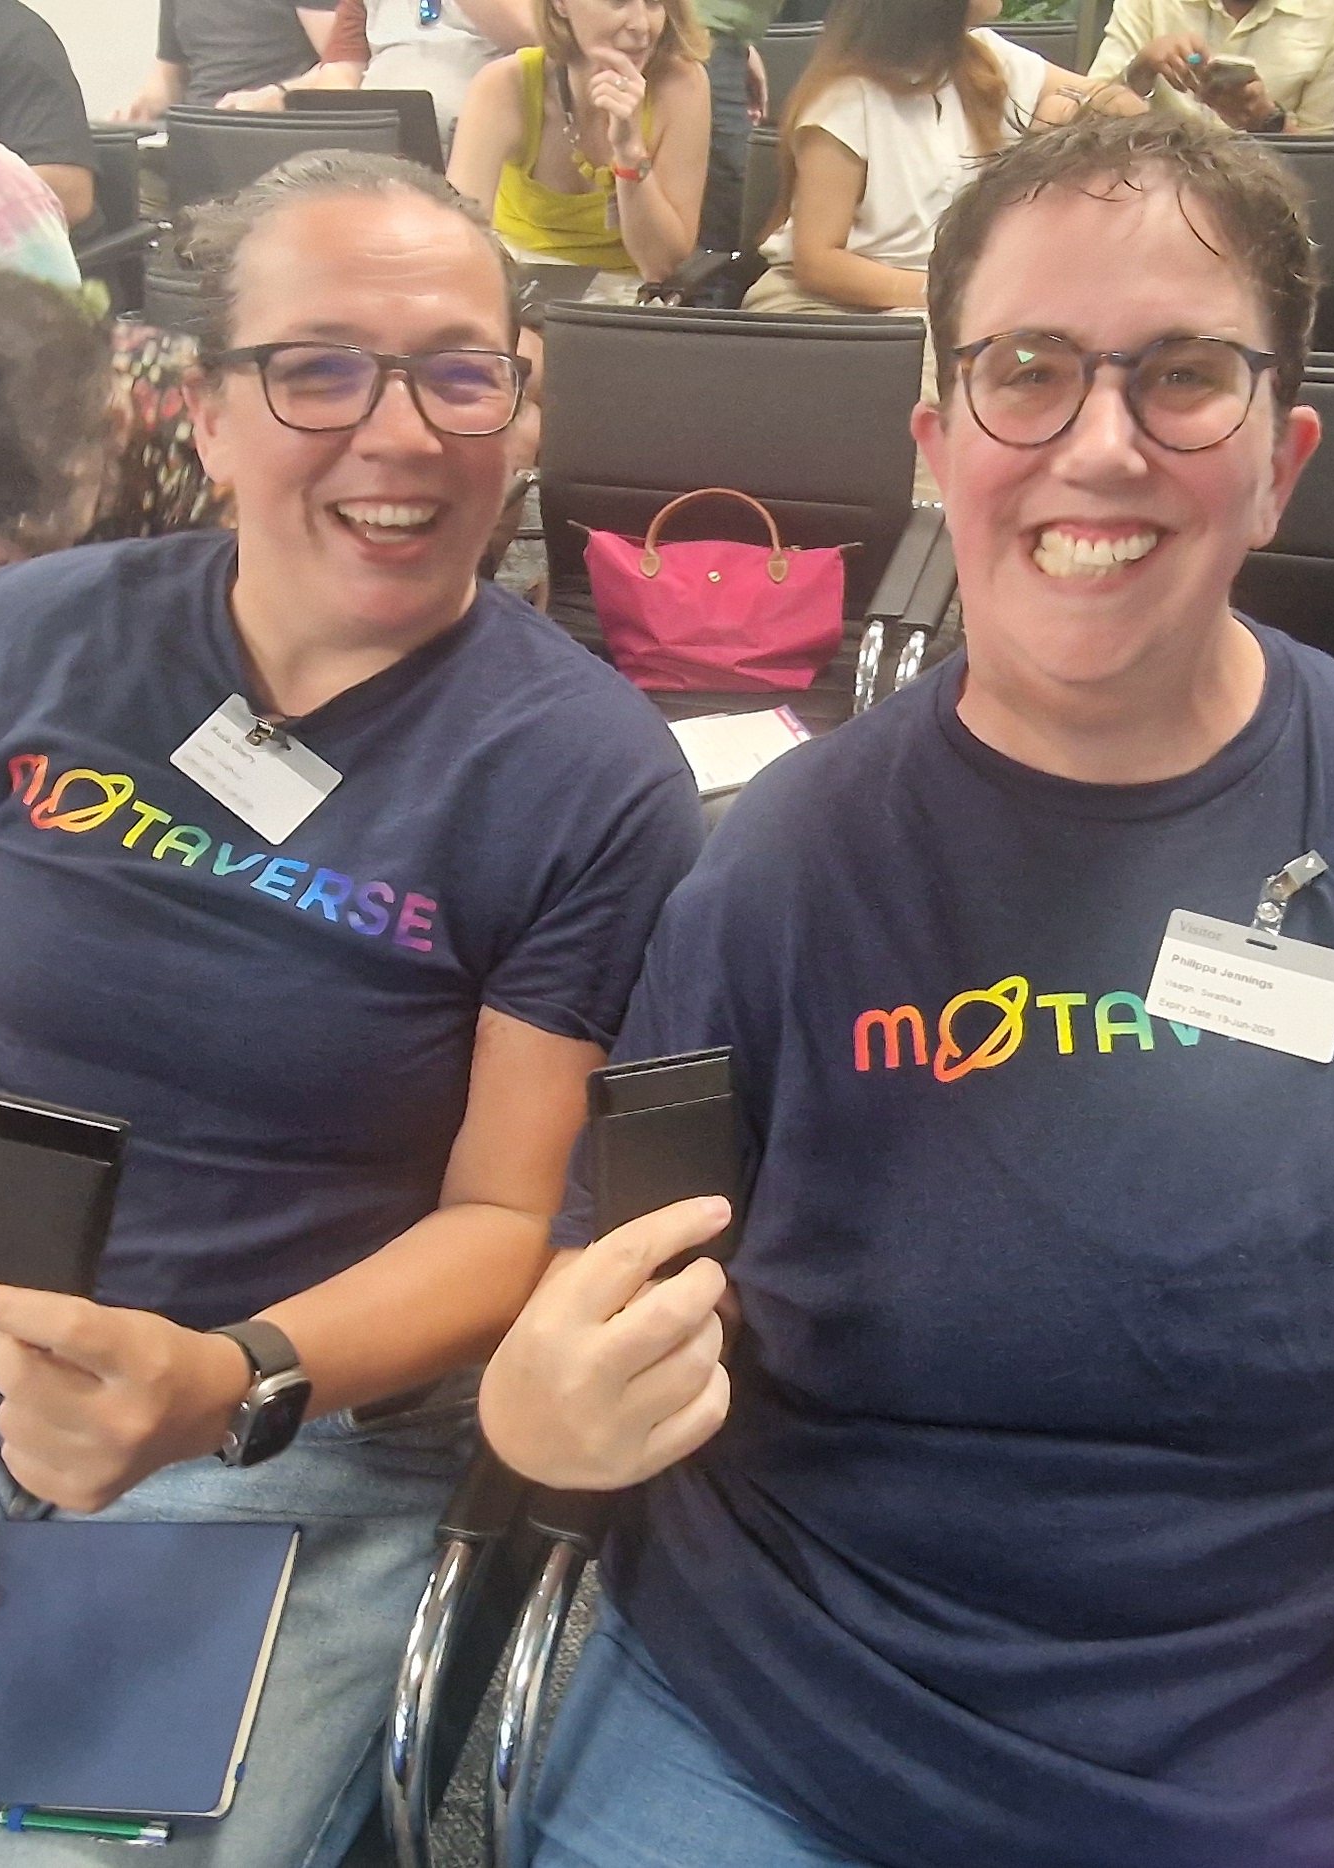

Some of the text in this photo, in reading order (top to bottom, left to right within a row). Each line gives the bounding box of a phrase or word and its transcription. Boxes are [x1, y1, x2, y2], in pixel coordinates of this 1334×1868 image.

[1171, 953, 1274, 990] Philippa Jennings
[1158, 997, 1186, 1013] Expiry
